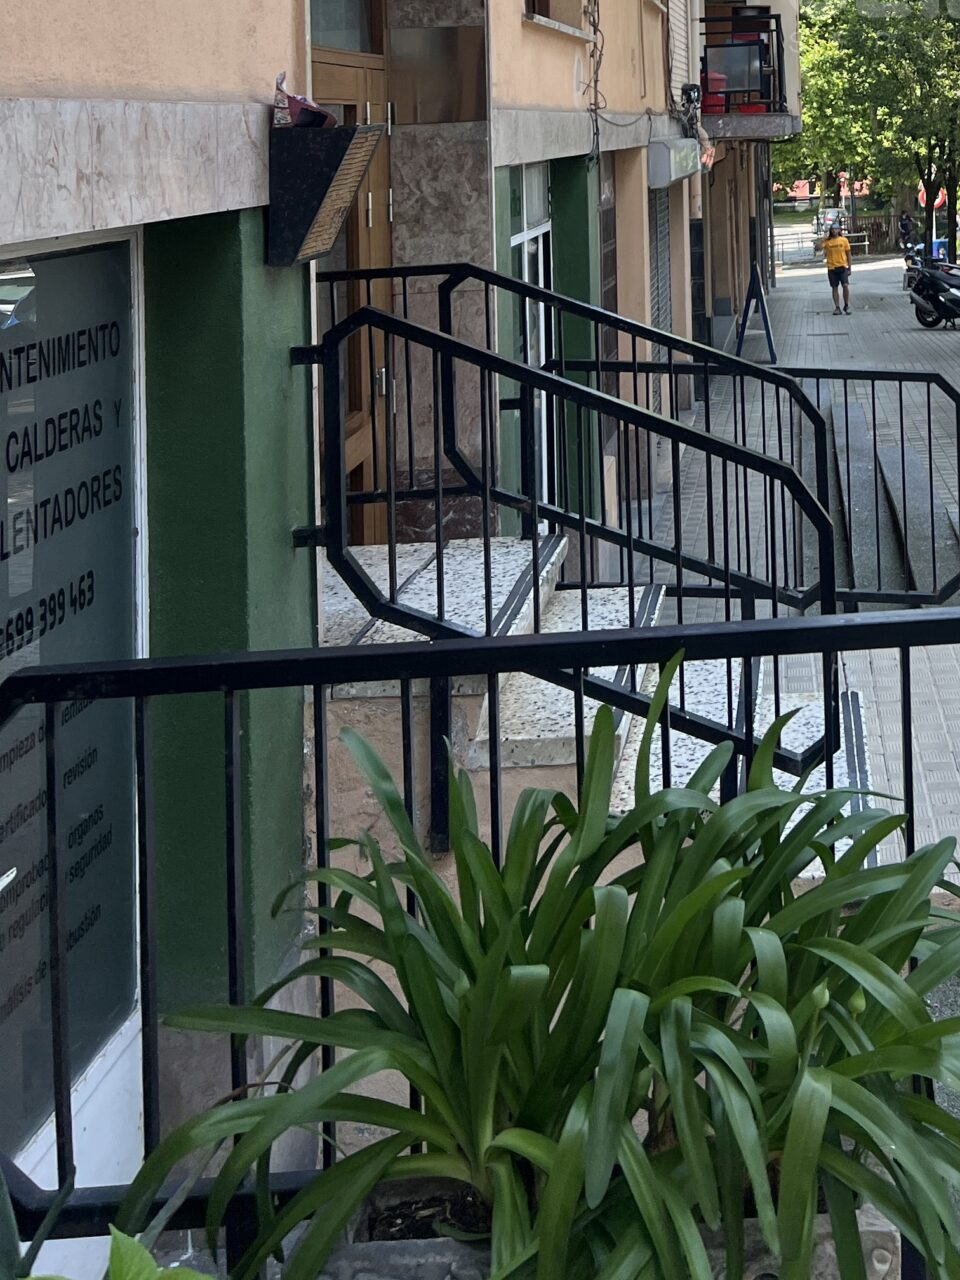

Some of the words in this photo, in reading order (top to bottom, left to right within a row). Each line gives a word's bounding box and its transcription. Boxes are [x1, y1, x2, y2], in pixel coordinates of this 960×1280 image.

[6, 399, 103, 473] CALDERAS
[114, 398, 122, 428] Y
[6, 606, 34, 657] 699
[39, 587, 66, 637] 399
[69, 569, 95, 615] 463
[63, 746, 98, 790] revisión
